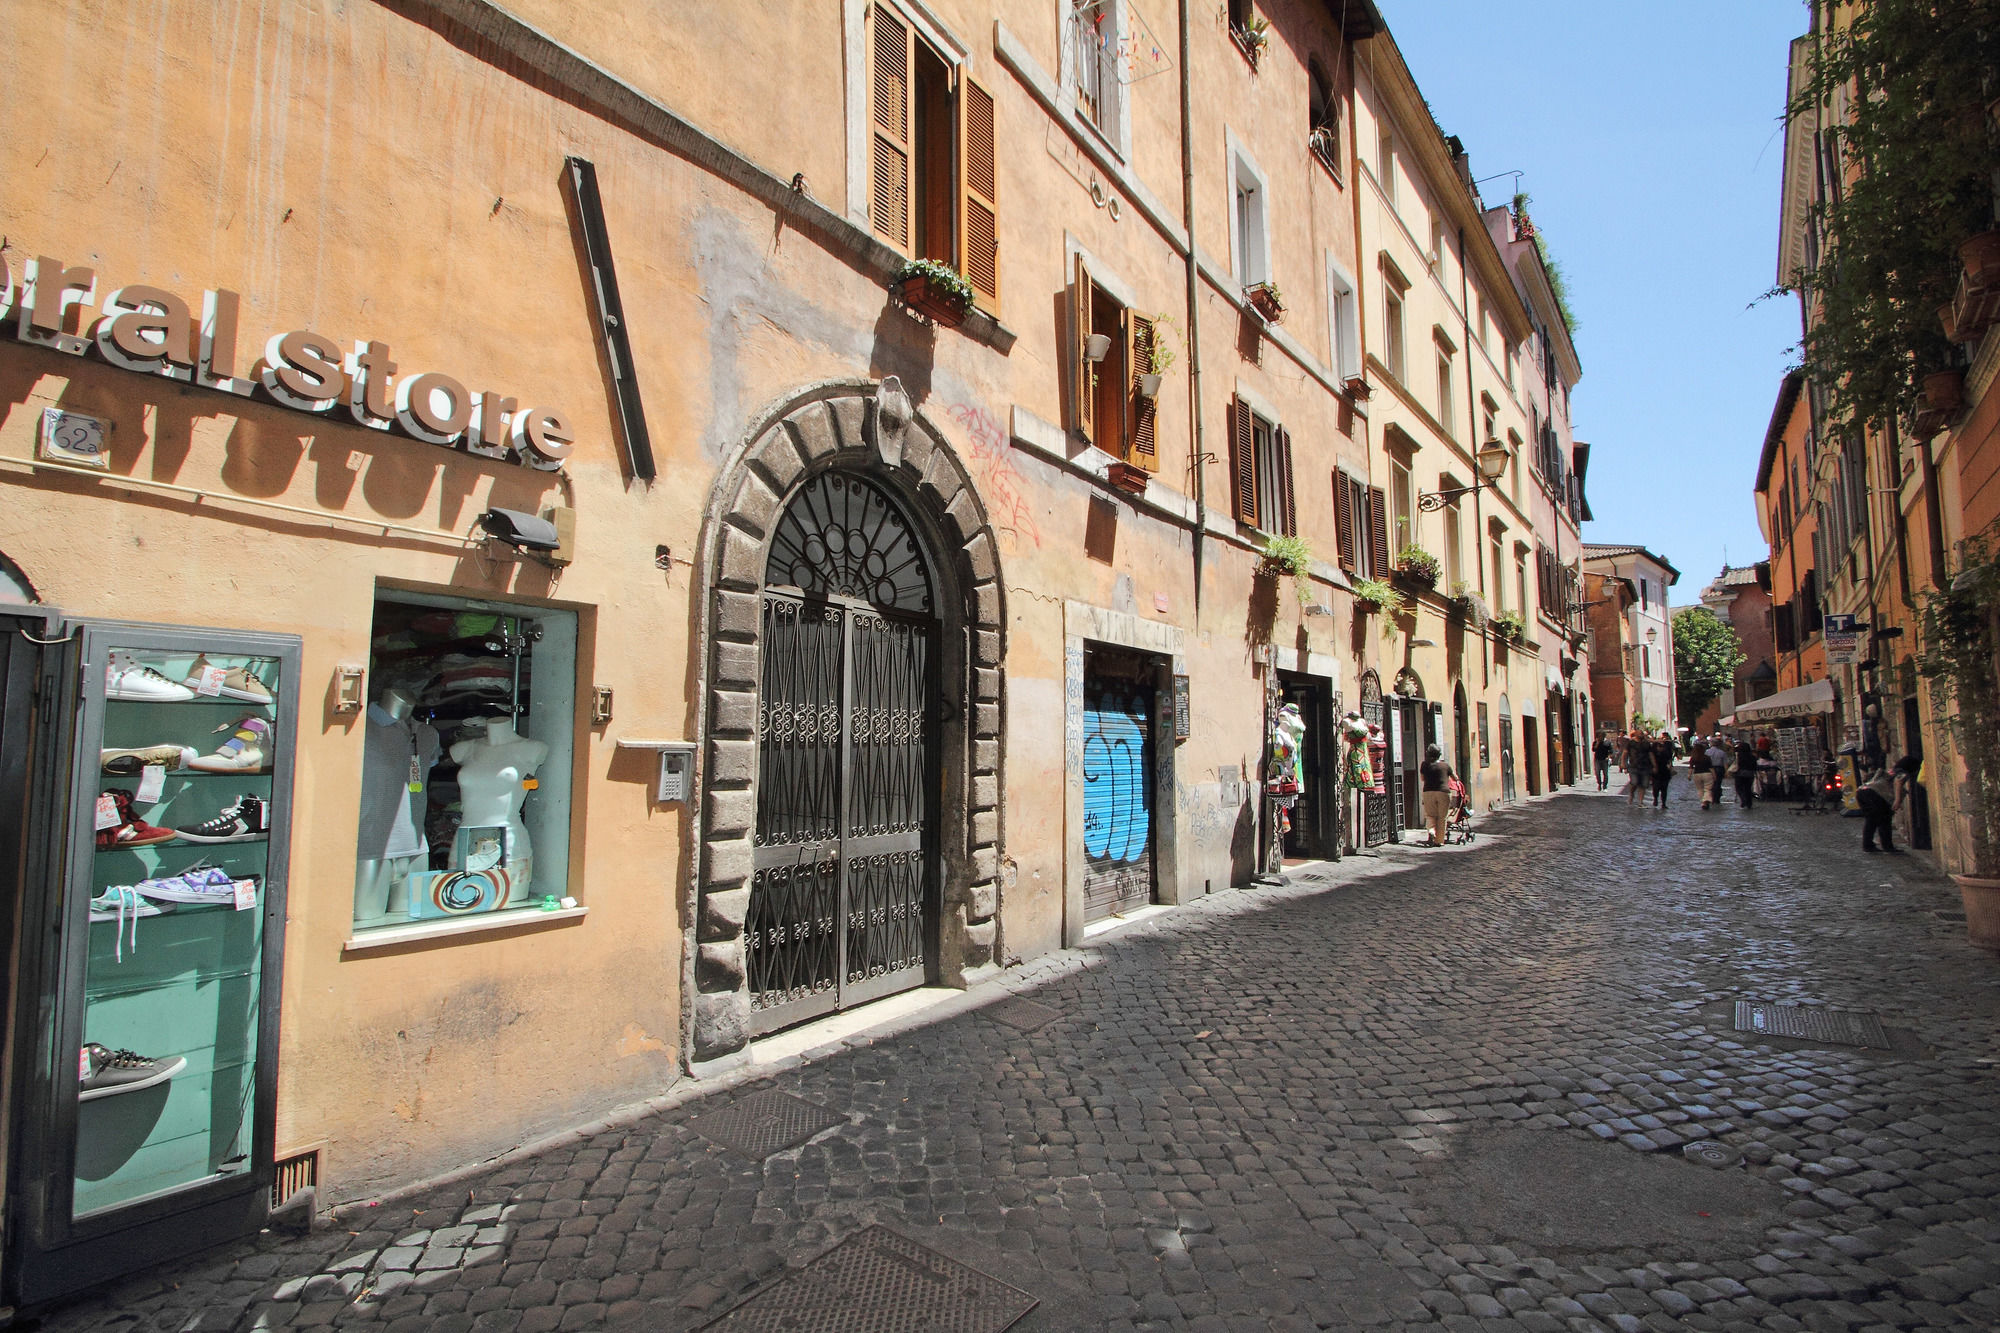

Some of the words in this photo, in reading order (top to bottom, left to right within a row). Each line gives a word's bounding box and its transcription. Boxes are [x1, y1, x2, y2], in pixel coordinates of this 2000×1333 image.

[0, 253, 248, 390] ral
[263, 331, 575, 468] store
[55, 425, 98, 454] 62a
[1757, 703, 1812, 717] PIZZERIA
